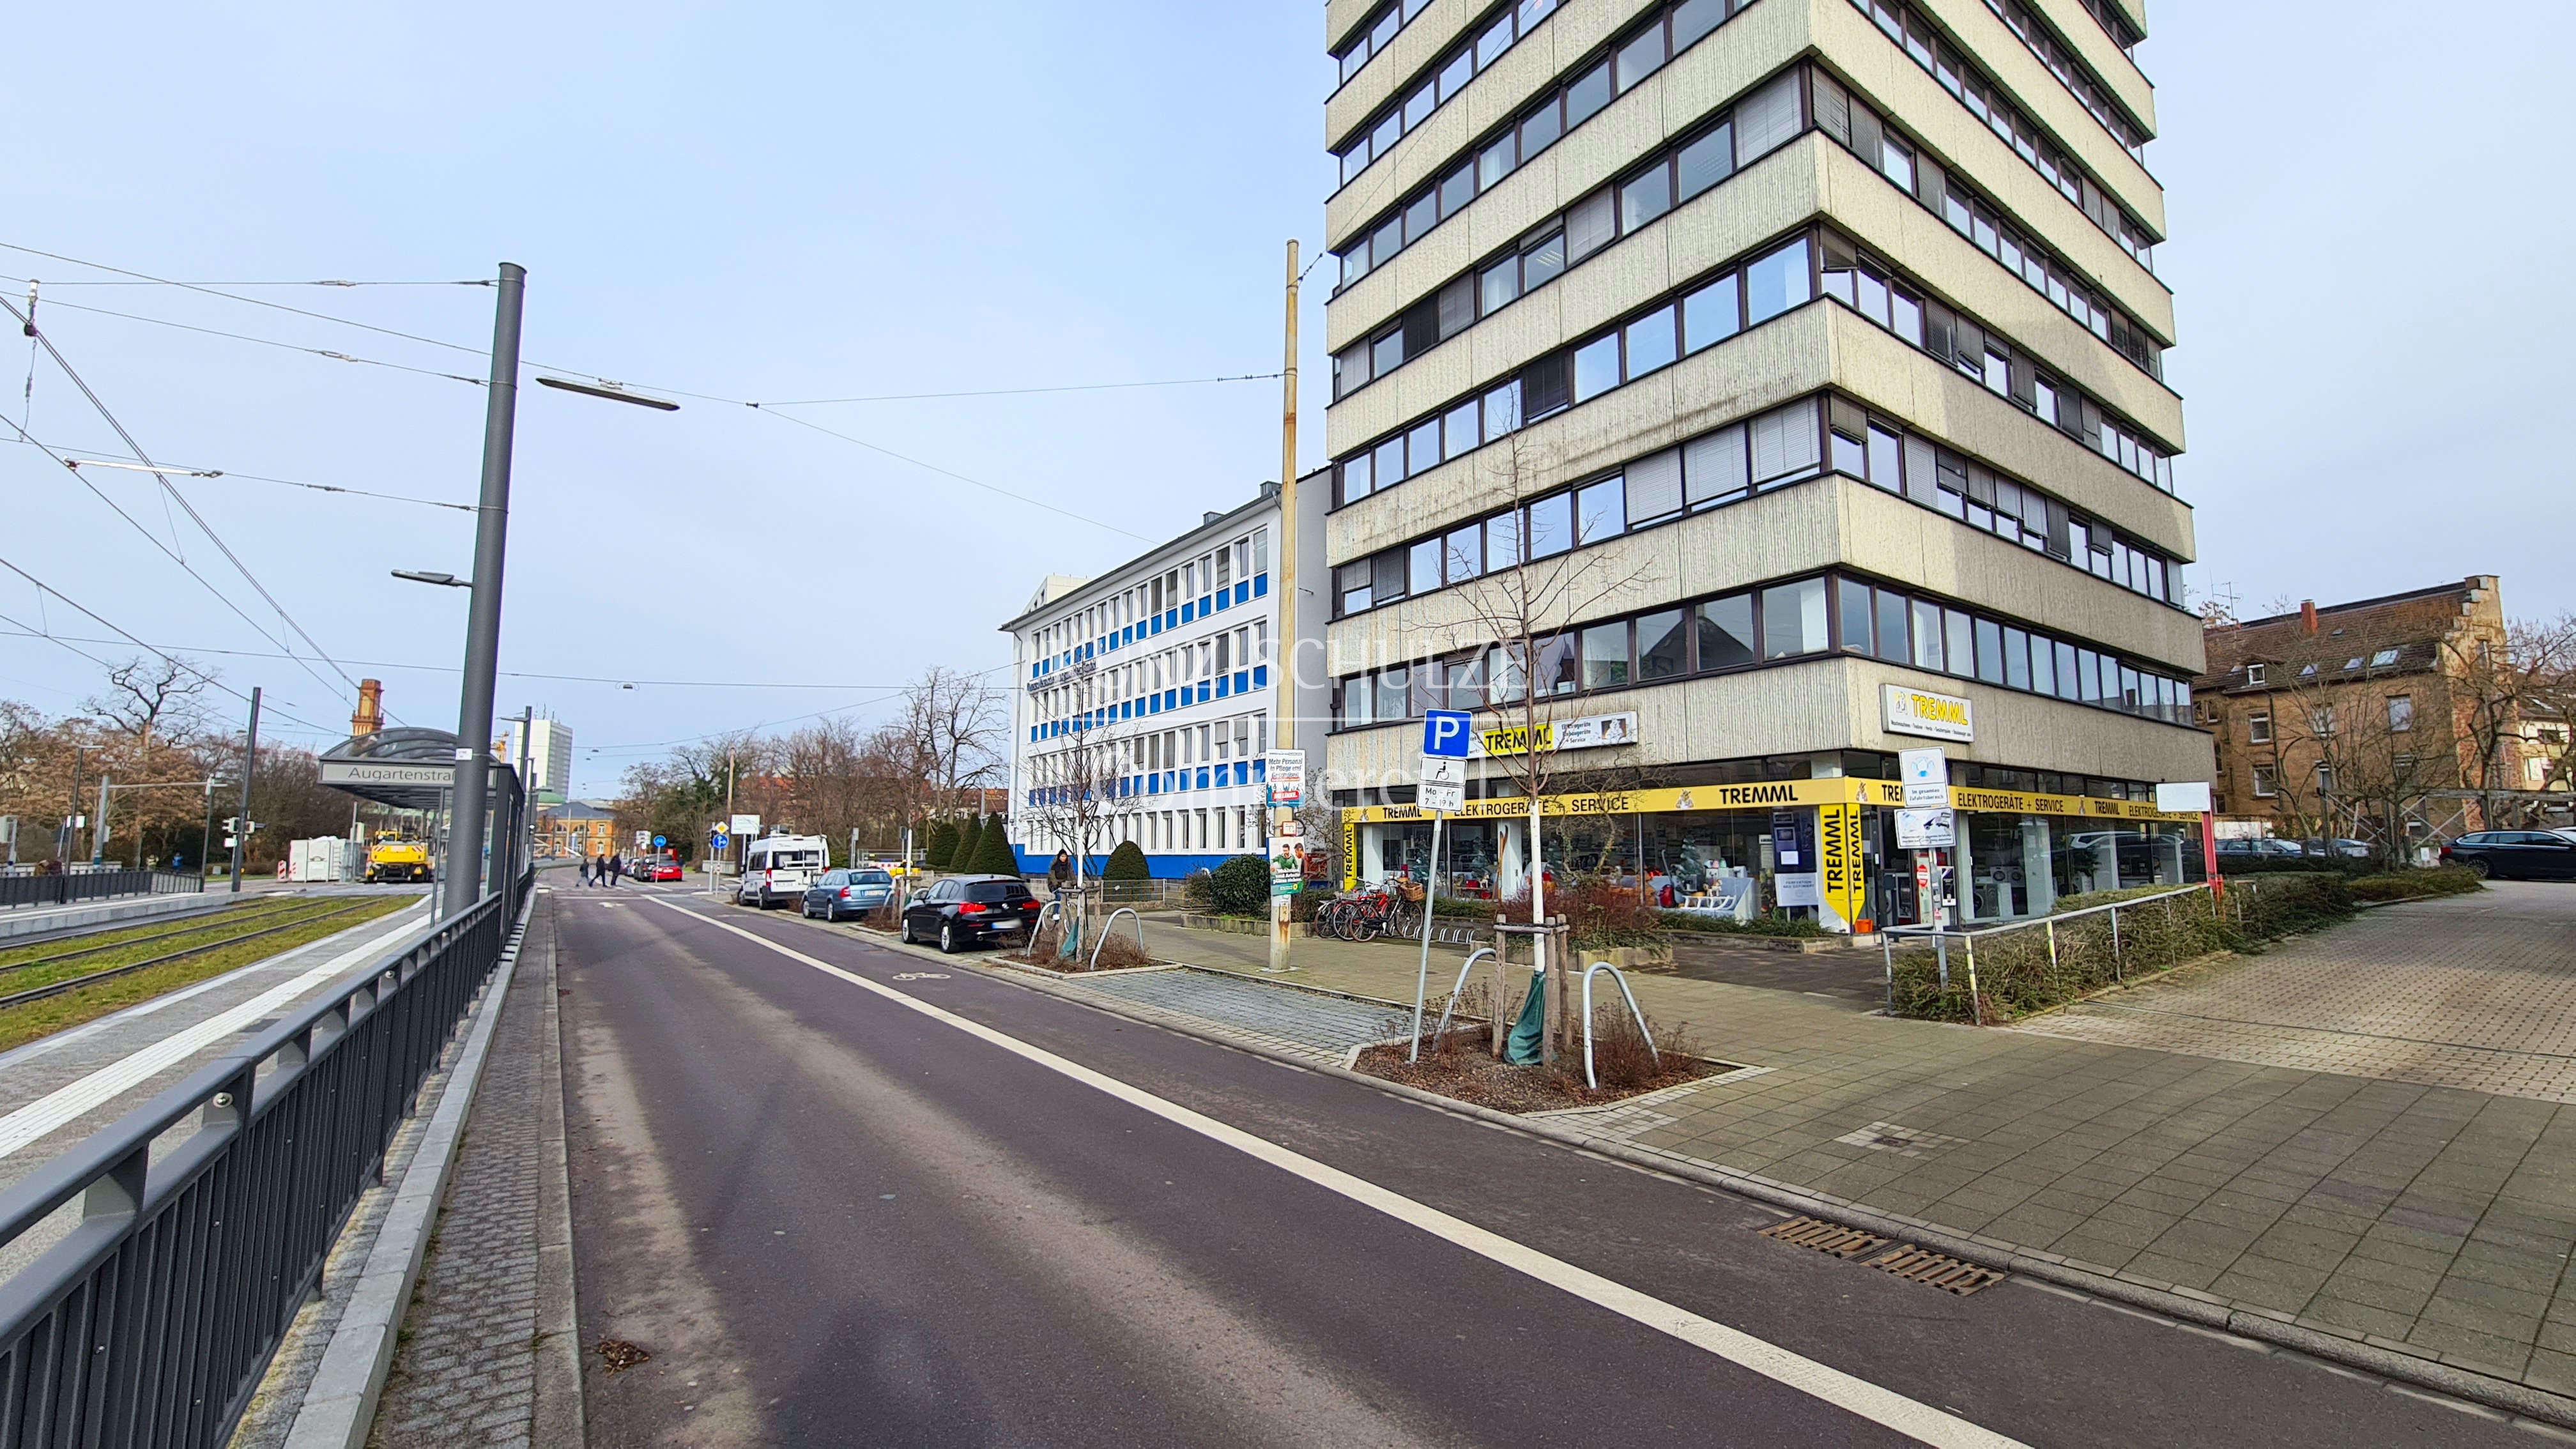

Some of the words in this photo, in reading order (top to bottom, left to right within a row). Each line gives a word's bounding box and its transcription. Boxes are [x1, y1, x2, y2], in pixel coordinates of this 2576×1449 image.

[1911, 694, 1968, 726] TREMML
[1434, 716, 1460, 749] P
[1485, 728, 1551, 751] TREMML
[348, 767, 455, 781] Augartenstra
[1425, 787, 1436, 795] Mo
[1446, 789, 1455, 797] Fr
[1719, 785, 1798, 804] TREMML
[1383, 806, 1422, 819] TREMML
[1454, 801, 1549, 816] LEKTROGERE
[1572, 797, 1629, 812] SERVICE
[1958, 793, 2023, 811] ELEKTROGERÄTE
[2027, 800, 2032, 810] +
[2035, 798, 2064, 812] SERVICE
[2094, 801, 2120, 815] TREMML
[1824, 809, 1843, 893] TREMML
[1850, 809, 1862, 894] TREMML
